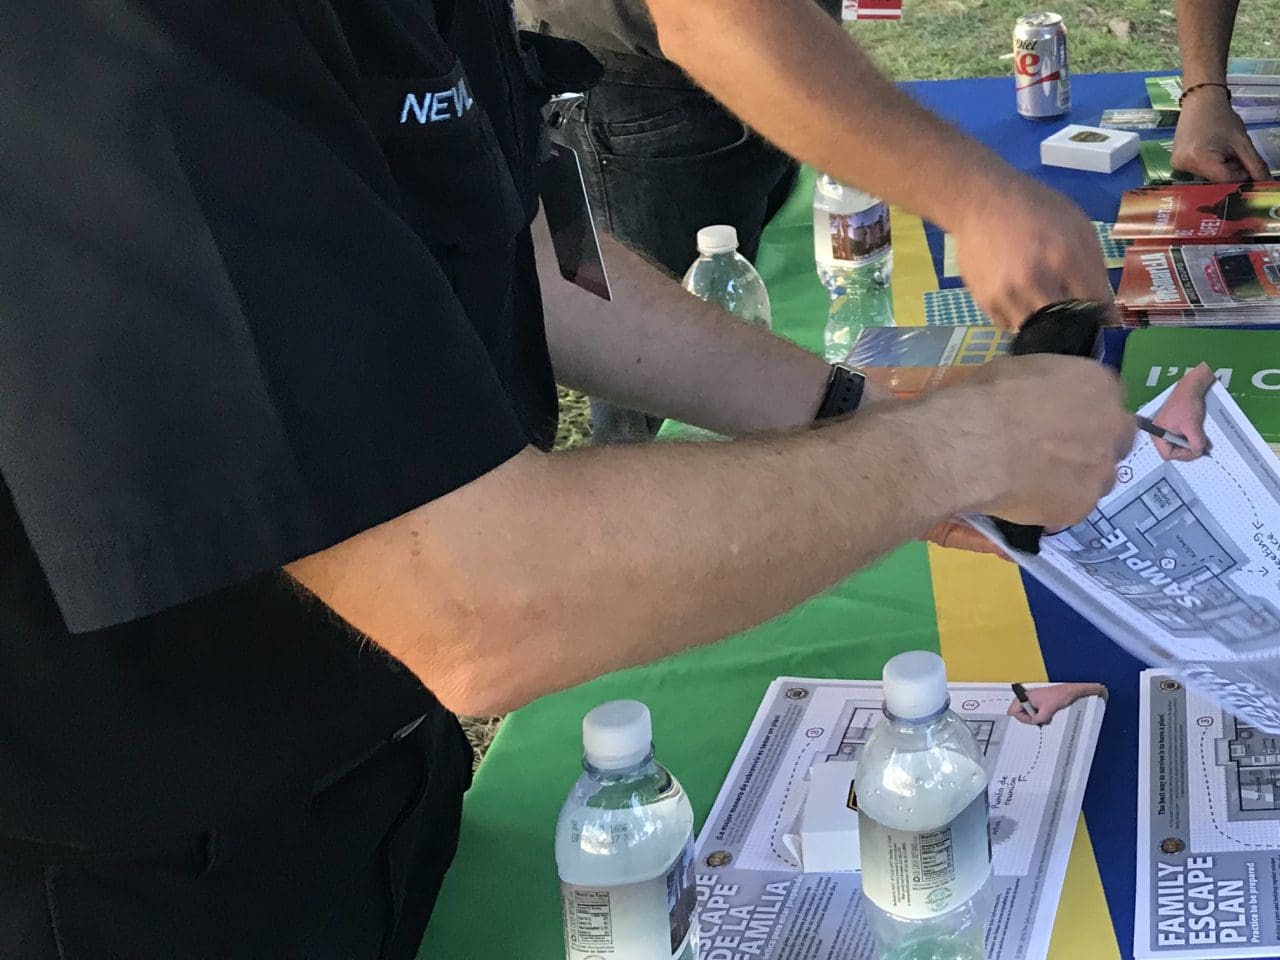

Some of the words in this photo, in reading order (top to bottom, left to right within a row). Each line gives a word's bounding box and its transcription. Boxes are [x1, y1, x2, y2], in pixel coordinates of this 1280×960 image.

[1101, 527, 1201, 608] SAMPLE
[991, 779, 1004, 809] Punto
[1000, 775, 1008, 787] de
[1187, 856, 1216, 944] ESCAPE
[1246, 862, 1259, 895] prepared
[722, 904, 756, 932] LA
[1157, 862, 1186, 946] FAMILY
[1217, 880, 1247, 944] PLAN
[1250, 915, 1260, 943] Practice
